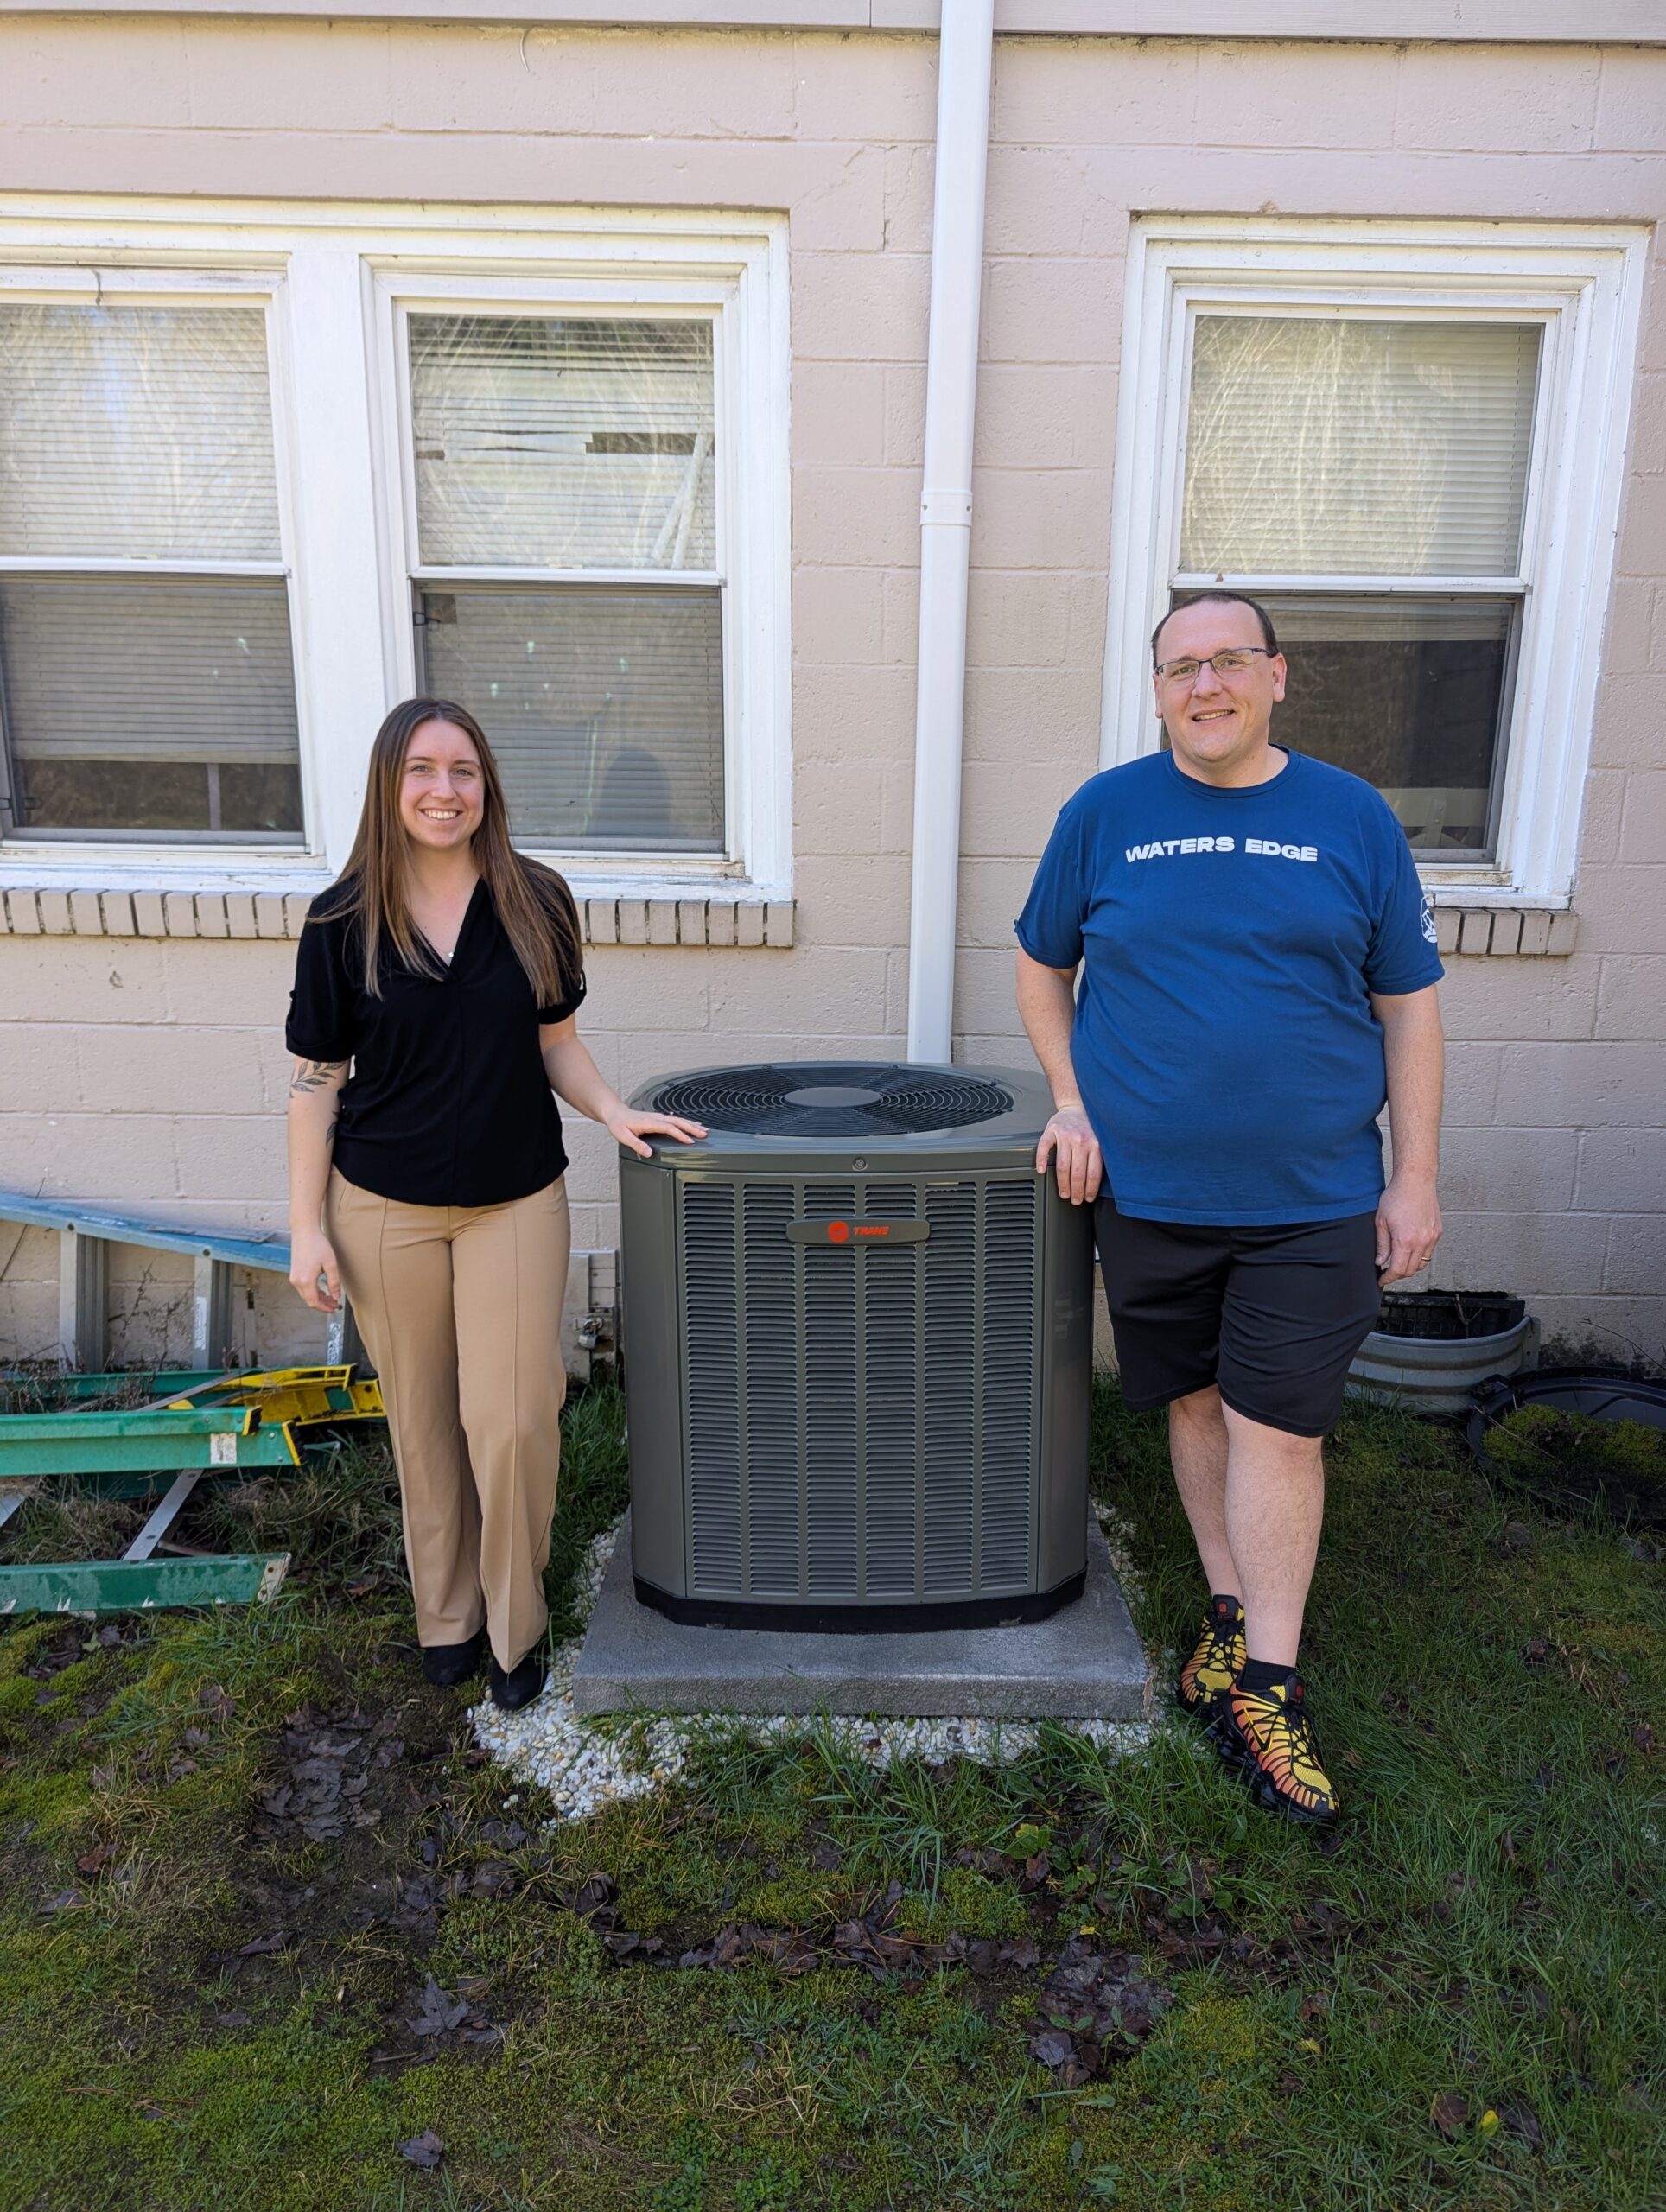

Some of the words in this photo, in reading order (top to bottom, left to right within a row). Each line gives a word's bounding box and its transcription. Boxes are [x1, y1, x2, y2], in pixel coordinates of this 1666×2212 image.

[1125, 836, 1235, 863] WATERS
[1245, 838, 1318, 861] EDGE
[854, 1226, 889, 1236] TRANE
